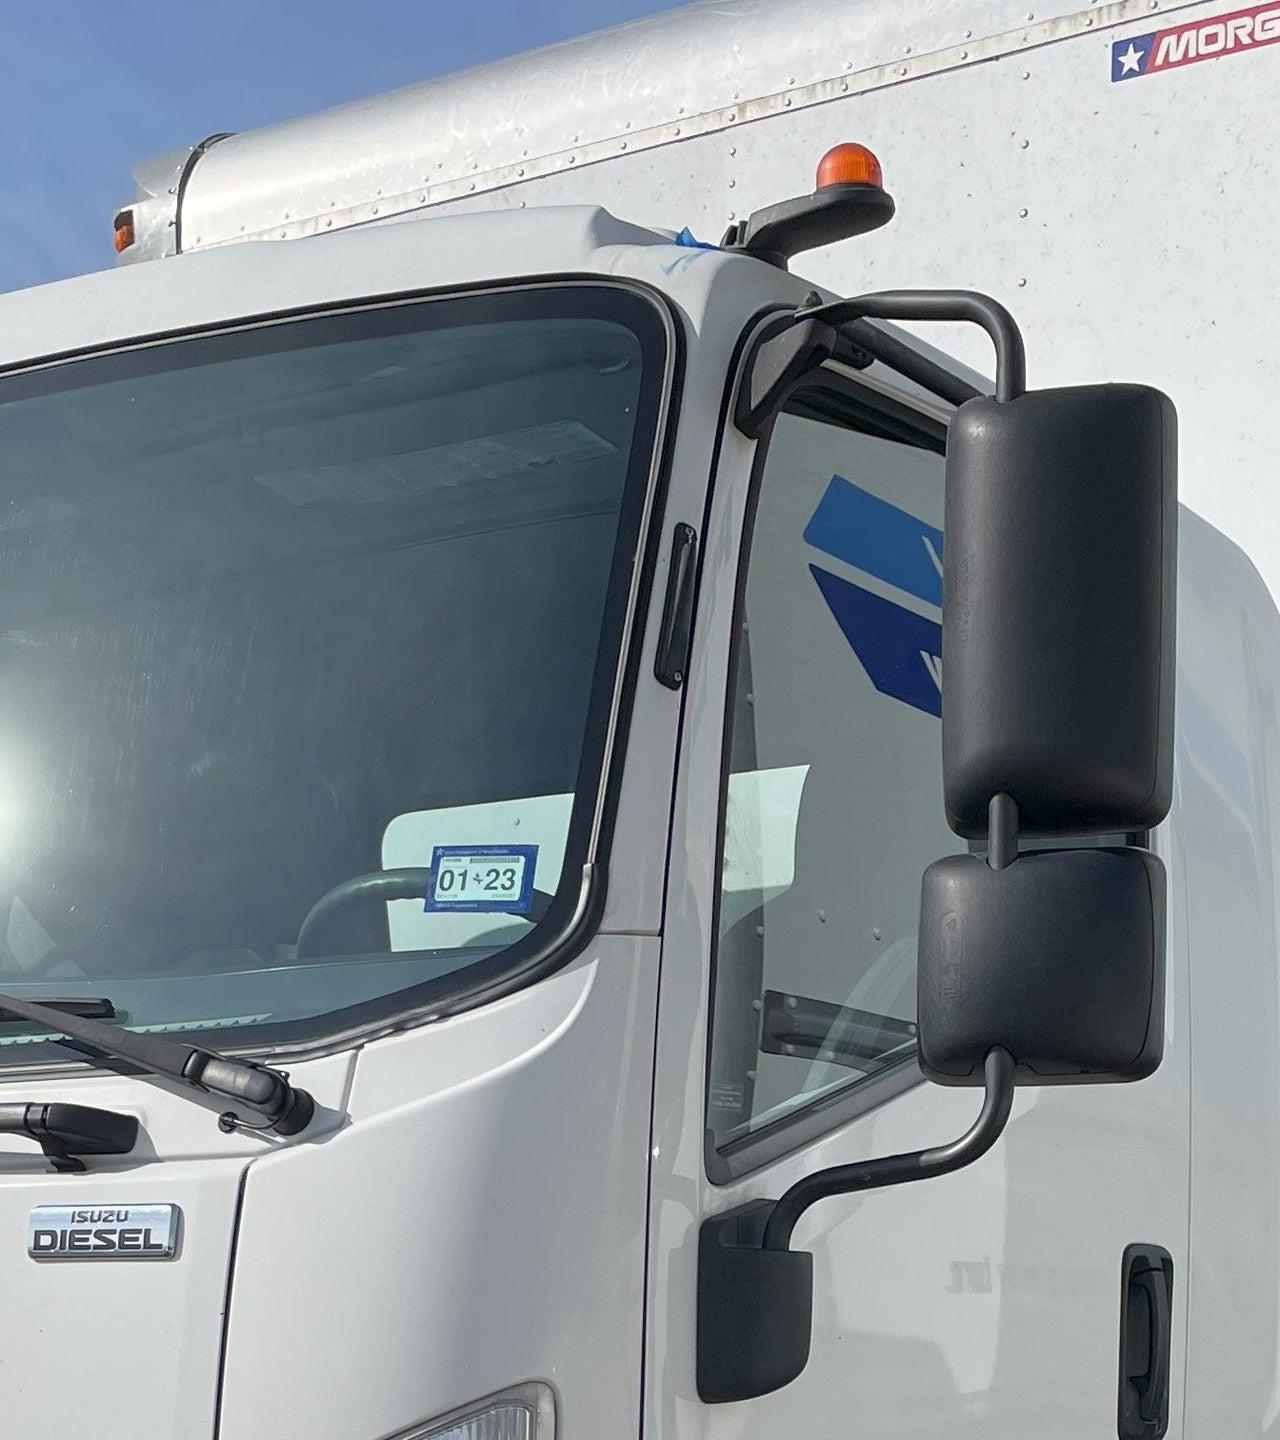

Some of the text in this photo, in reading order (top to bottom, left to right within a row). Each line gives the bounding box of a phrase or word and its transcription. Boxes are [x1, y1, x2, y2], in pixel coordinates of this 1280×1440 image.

[438, 868, 517, 892] 01 23
[70, 1210, 130, 1224] ISUZU
[33, 1228, 164, 1251] DIESEL
